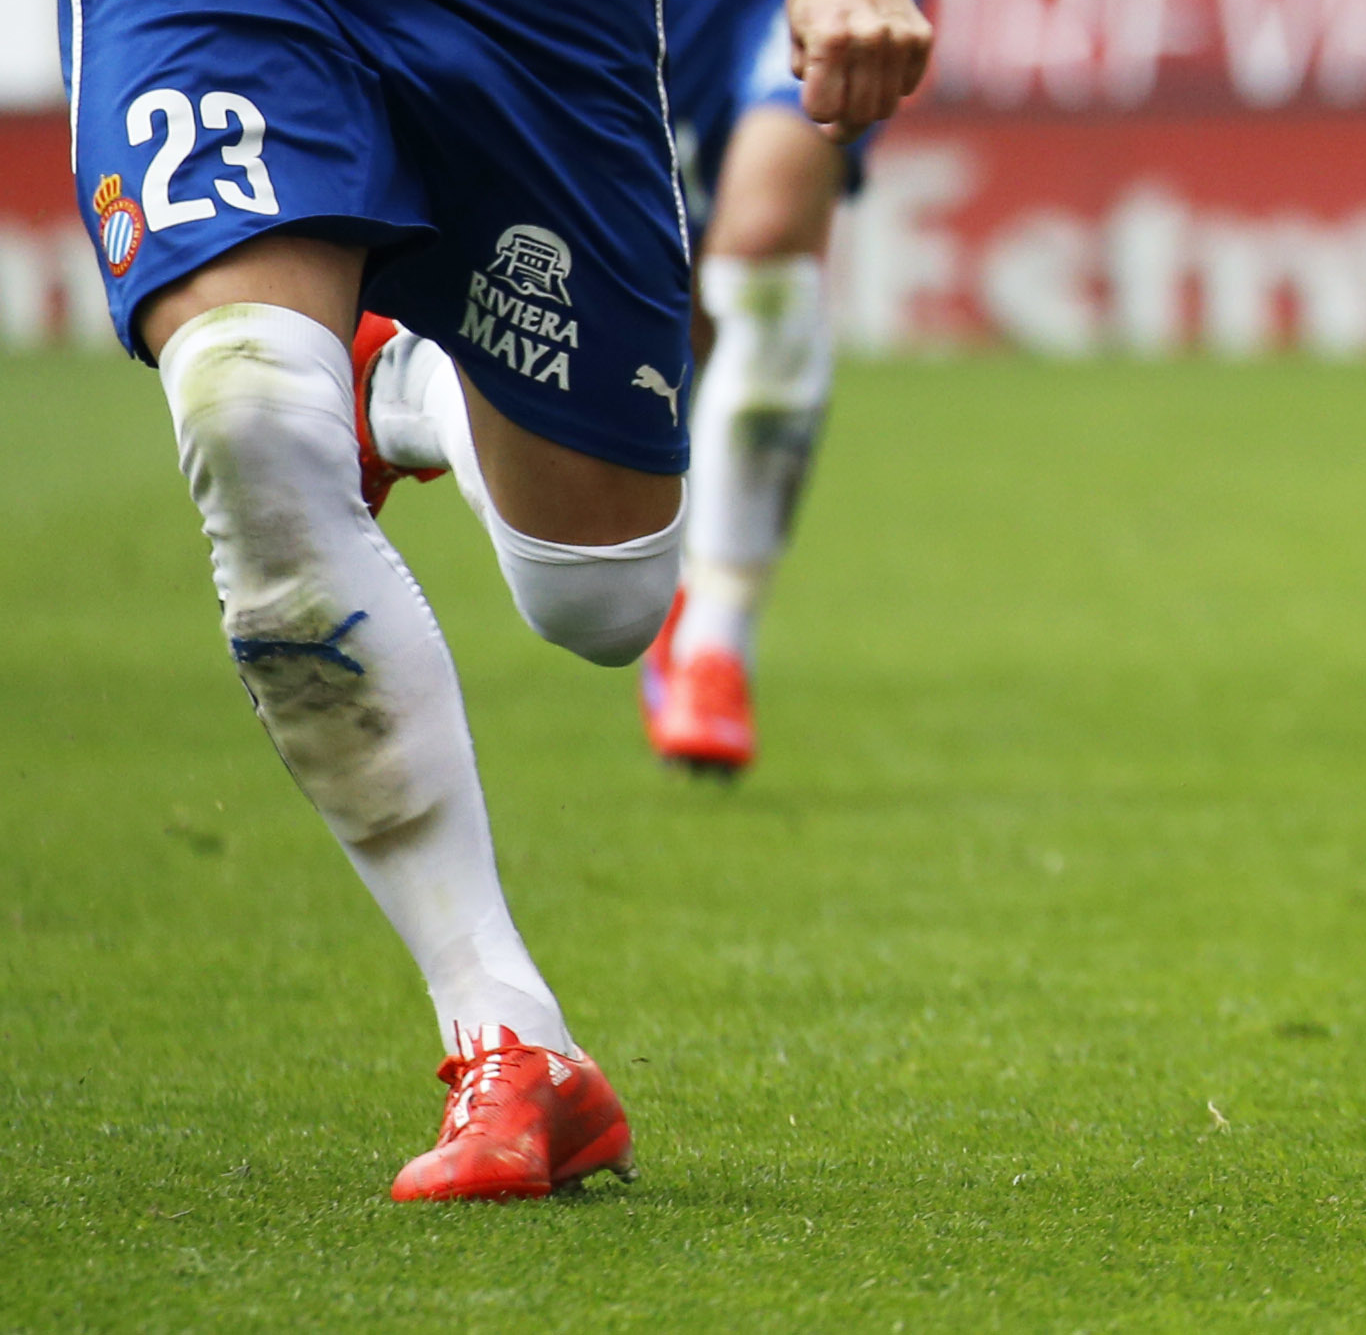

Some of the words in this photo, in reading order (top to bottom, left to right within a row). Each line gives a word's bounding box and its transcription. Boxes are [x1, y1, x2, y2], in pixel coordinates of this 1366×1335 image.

[126, 88, 280, 233] 23
[457, 299, 570, 391] MAYA
[468, 270, 579, 349] RIVIERA
